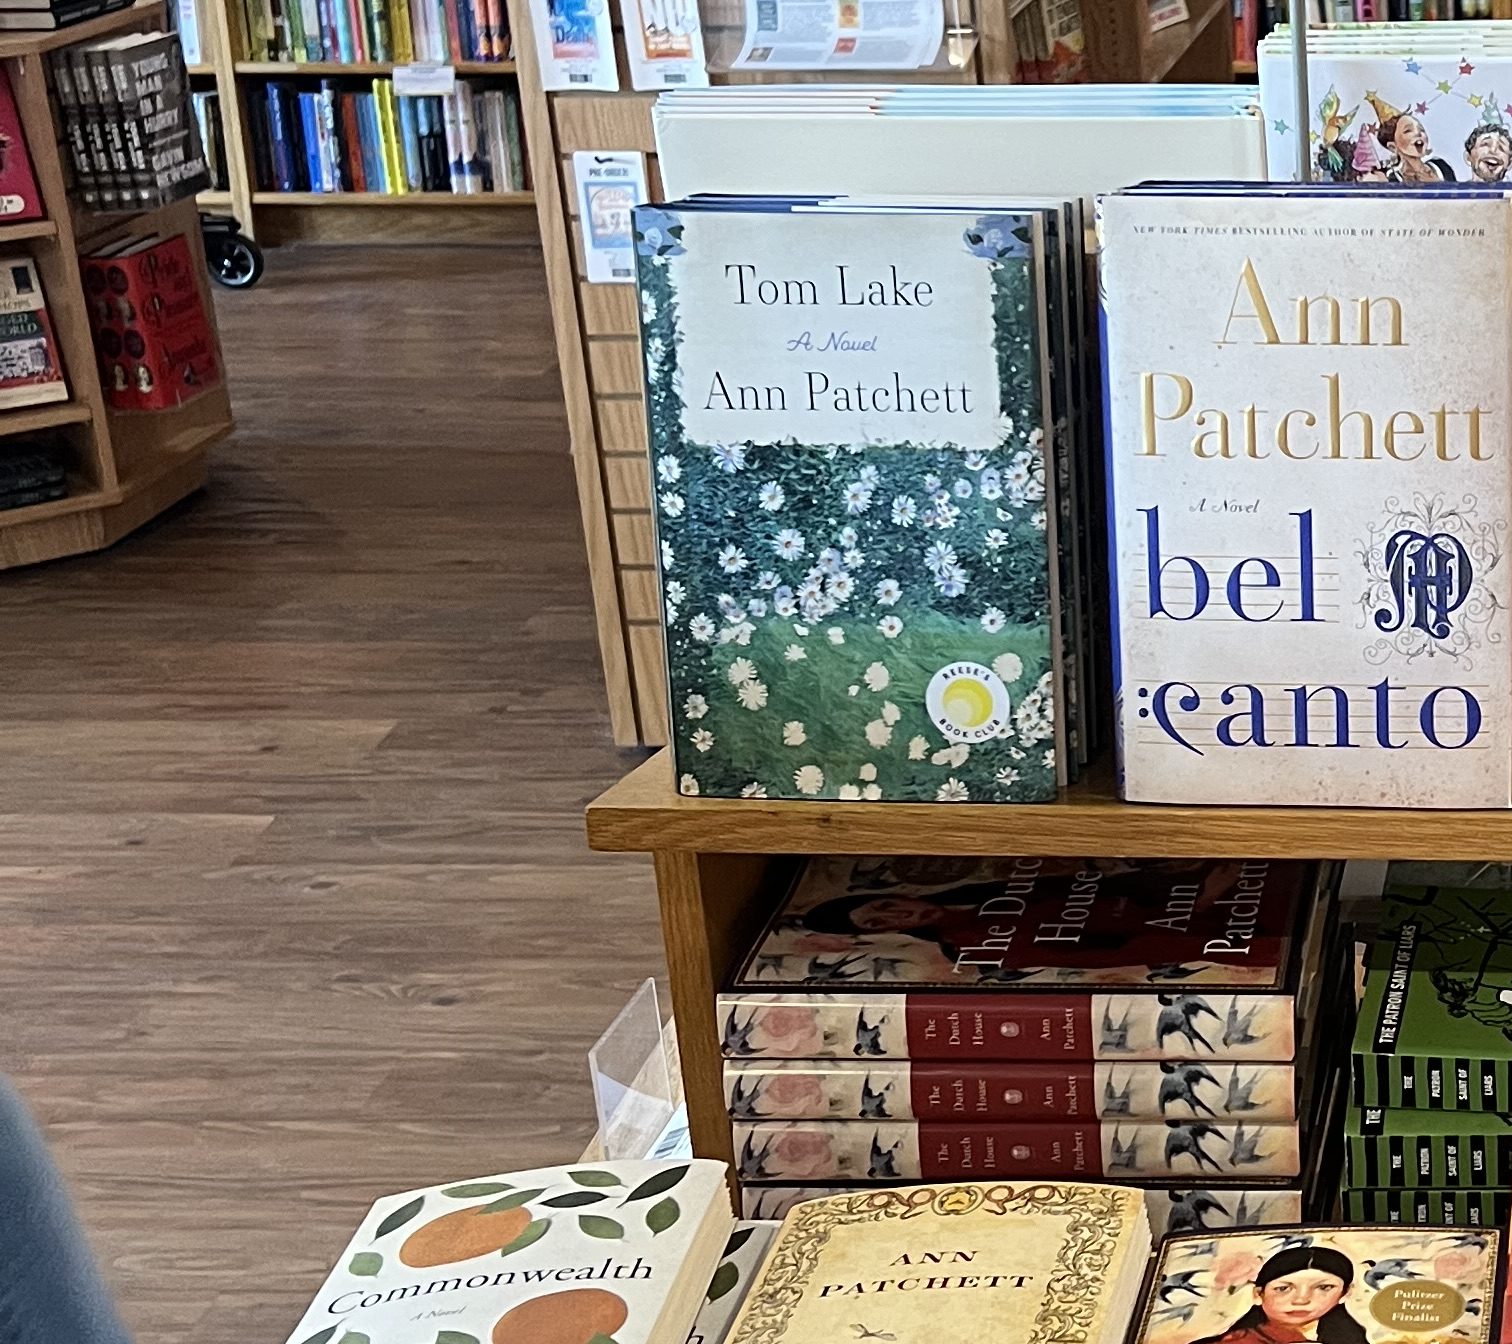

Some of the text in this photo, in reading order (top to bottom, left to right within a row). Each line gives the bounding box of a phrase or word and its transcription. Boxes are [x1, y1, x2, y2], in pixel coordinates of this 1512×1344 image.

[1133, 225, 1157, 235] NEW
[1160, 226, 1188, 235] YORK
[1193, 226, 1229, 236] TIMES
[1313, 227, 1357, 237] AUTHOR
[1360, 228, 1374, 237] OF
[1380, 228, 1416, 237] STATE
[1419, 228, 1433, 237] OF
[1438, 227, 1486, 237] WONDER
[724, 264, 934, 308] Tom Lake
[1214, 257, 1409, 347] Ann
[786, 332, 878, 353] A Novel
[704, 372, 974, 413] Ann Patchett
[1133, 372, 1496, 462] Patchett
[1189, 498, 1259, 515] A Novel
[1136, 505, 1326, 622] bel
[942, 668, 992, 682] REESE'S
[939, 716, 1002, 739] BOOK CLUB
[1152, 676, 1483, 756] canto
[952, 858, 1043, 974] The Dutc
[1033, 871, 1102, 943] House
[1144, 882, 1200, 932] Ann
[1202, 861, 1269, 955] Patchett
[1378, 924, 1417, 1044] THE PATRON SAINT OF LIARS
[924, 1007, 1075, 1051] The Dutch House Ann Patchett
[889, 1250, 979, 1267] ANN
[327, 1257, 653, 1315] Commonwealth
[817, 1274, 1035, 1298] PATCHETT
